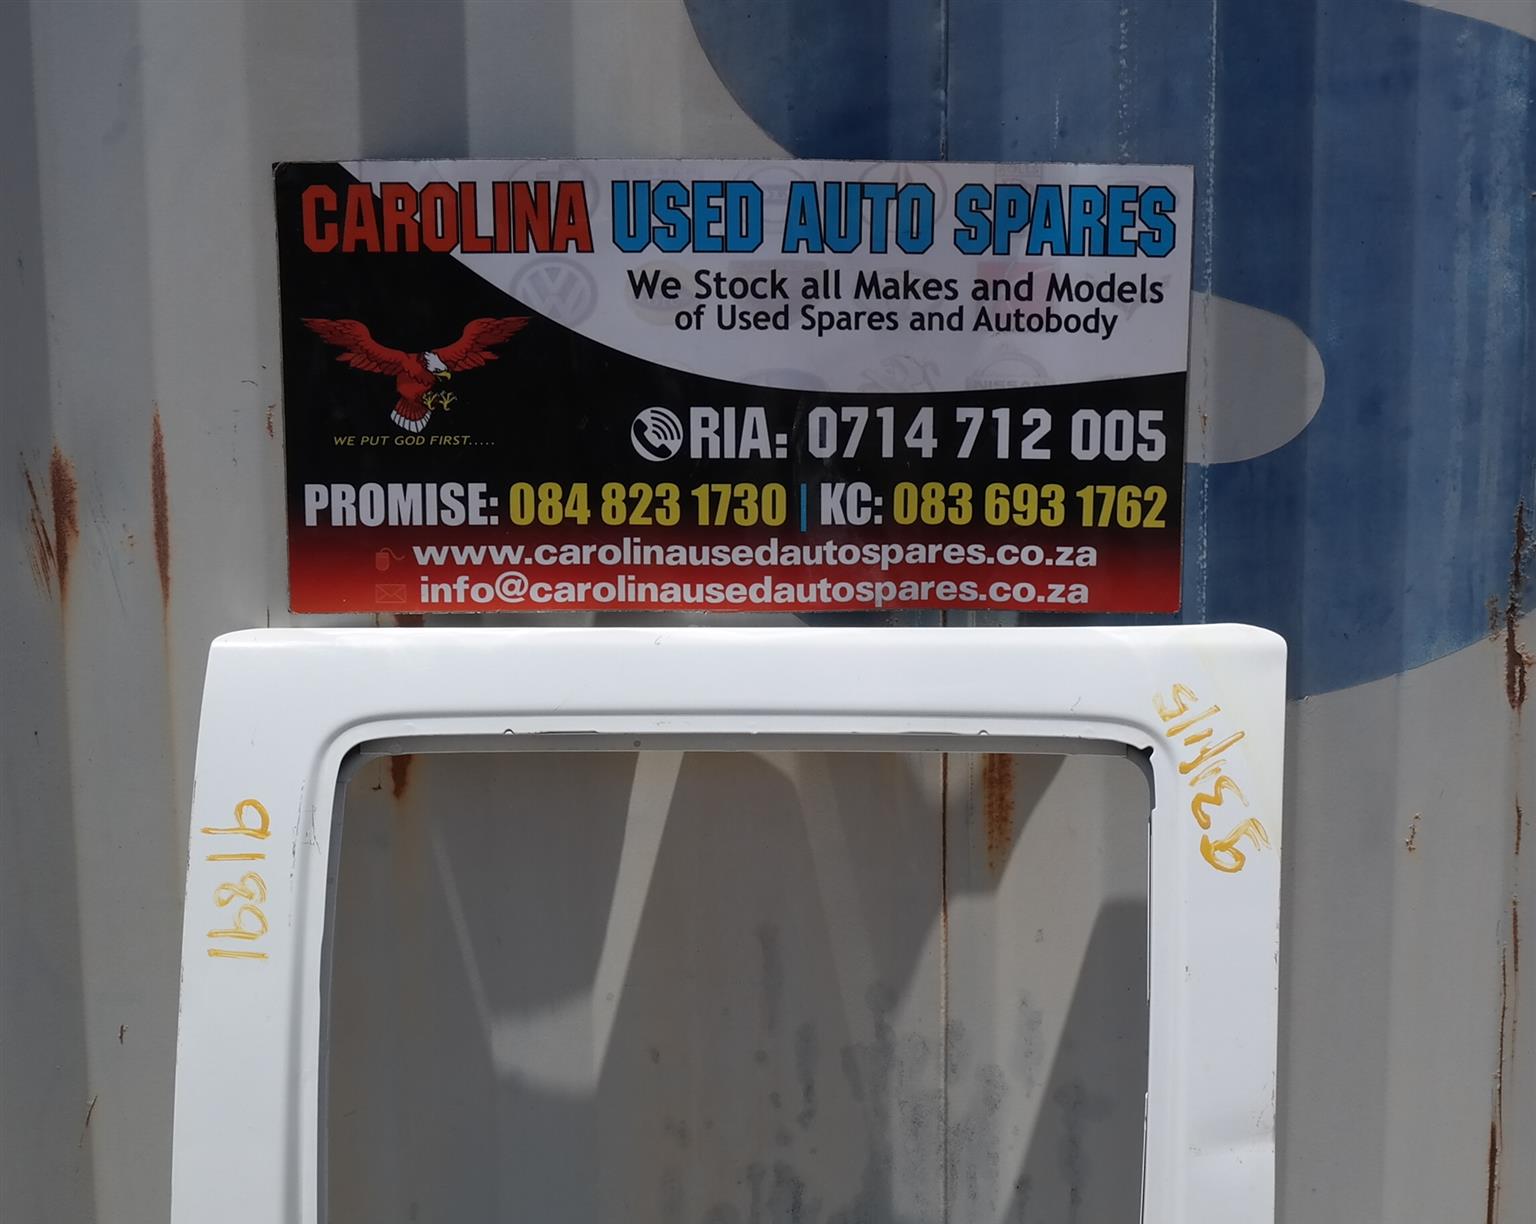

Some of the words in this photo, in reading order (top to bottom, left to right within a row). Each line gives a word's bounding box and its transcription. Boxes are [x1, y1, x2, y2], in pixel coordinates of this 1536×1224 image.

[302, 181, 594, 254] CAROLINA
[611, 180, 763, 253] USED
[781, 180, 935, 254] AUTO
[954, 183, 1176, 257] SPARES
[627, 269, 681, 299] We
[694, 269, 789, 300] Stock
[801, 269, 842, 300] all
[854, 271, 958, 301] Makes
[971, 272, 1033, 302] and
[1046, 273, 1164, 304] Models
[674, 304, 706, 331] of
[716, 305, 791, 331] Used
[800, 303, 899, 337] Spares
[909, 307, 963, 332] and
[972, 307, 1118, 340] Autobody
[333, 436, 356, 446] WE
[360, 436, 389, 446] PUT
[394, 435, 426, 446] GOD
[690, 406, 788, 459] RIA:
[808, 407, 938, 459] 0714
[955, 407, 1052, 460] 712
[1071, 409, 1167, 462] 005
[304, 483, 499, 527] PROMISE:
[509, 482, 591, 526] 084
[602, 482, 681, 525] 823
[691, 482, 787, 526] 1730
[820, 481, 883, 526] KC:
[893, 481, 973, 525] 083
[984, 483, 1066, 527] 693
[1075, 485, 1167, 528] 1762
[412, 537, 1098, 570] www.carolinausedautospares.co.za
[420, 571, 1090, 607] info@carolinausedautospares.co.za
